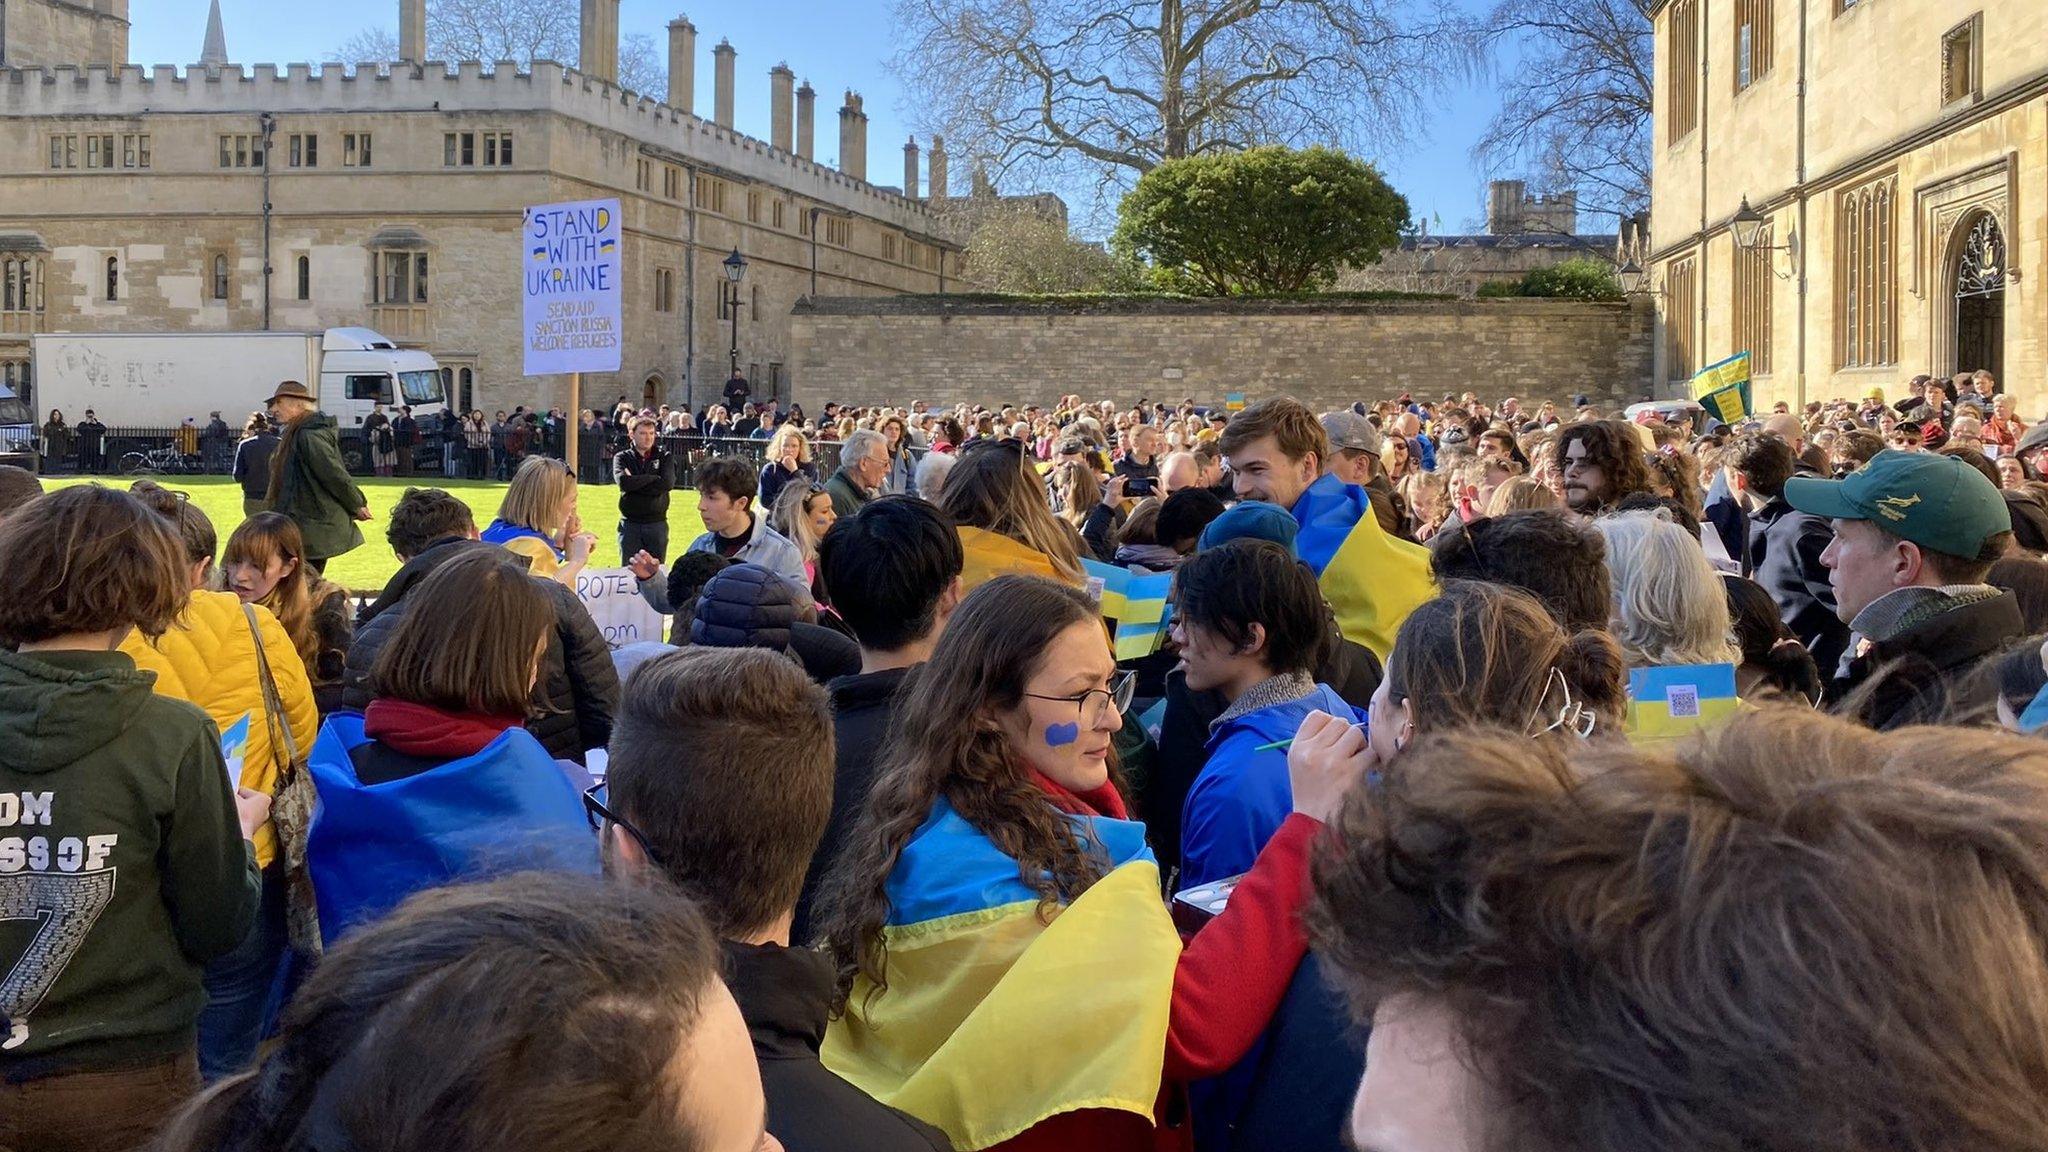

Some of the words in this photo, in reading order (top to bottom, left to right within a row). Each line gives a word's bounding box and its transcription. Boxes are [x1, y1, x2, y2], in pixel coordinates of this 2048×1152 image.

[534, 207, 610, 238] STAND
[547, 235, 596, 264] WITH
[527, 264, 610, 296] UKRAINE
[547, 302, 575, 318] SEND
[576, 300, 595, 316] AID
[535, 319, 578, 335] SANCTION
[581, 317, 612, 332] RUSSIA
[530, 335, 570, 351] WELCOME
[571, 333, 617, 349] REFUGEES
[57, 834, 118, 872] OF
